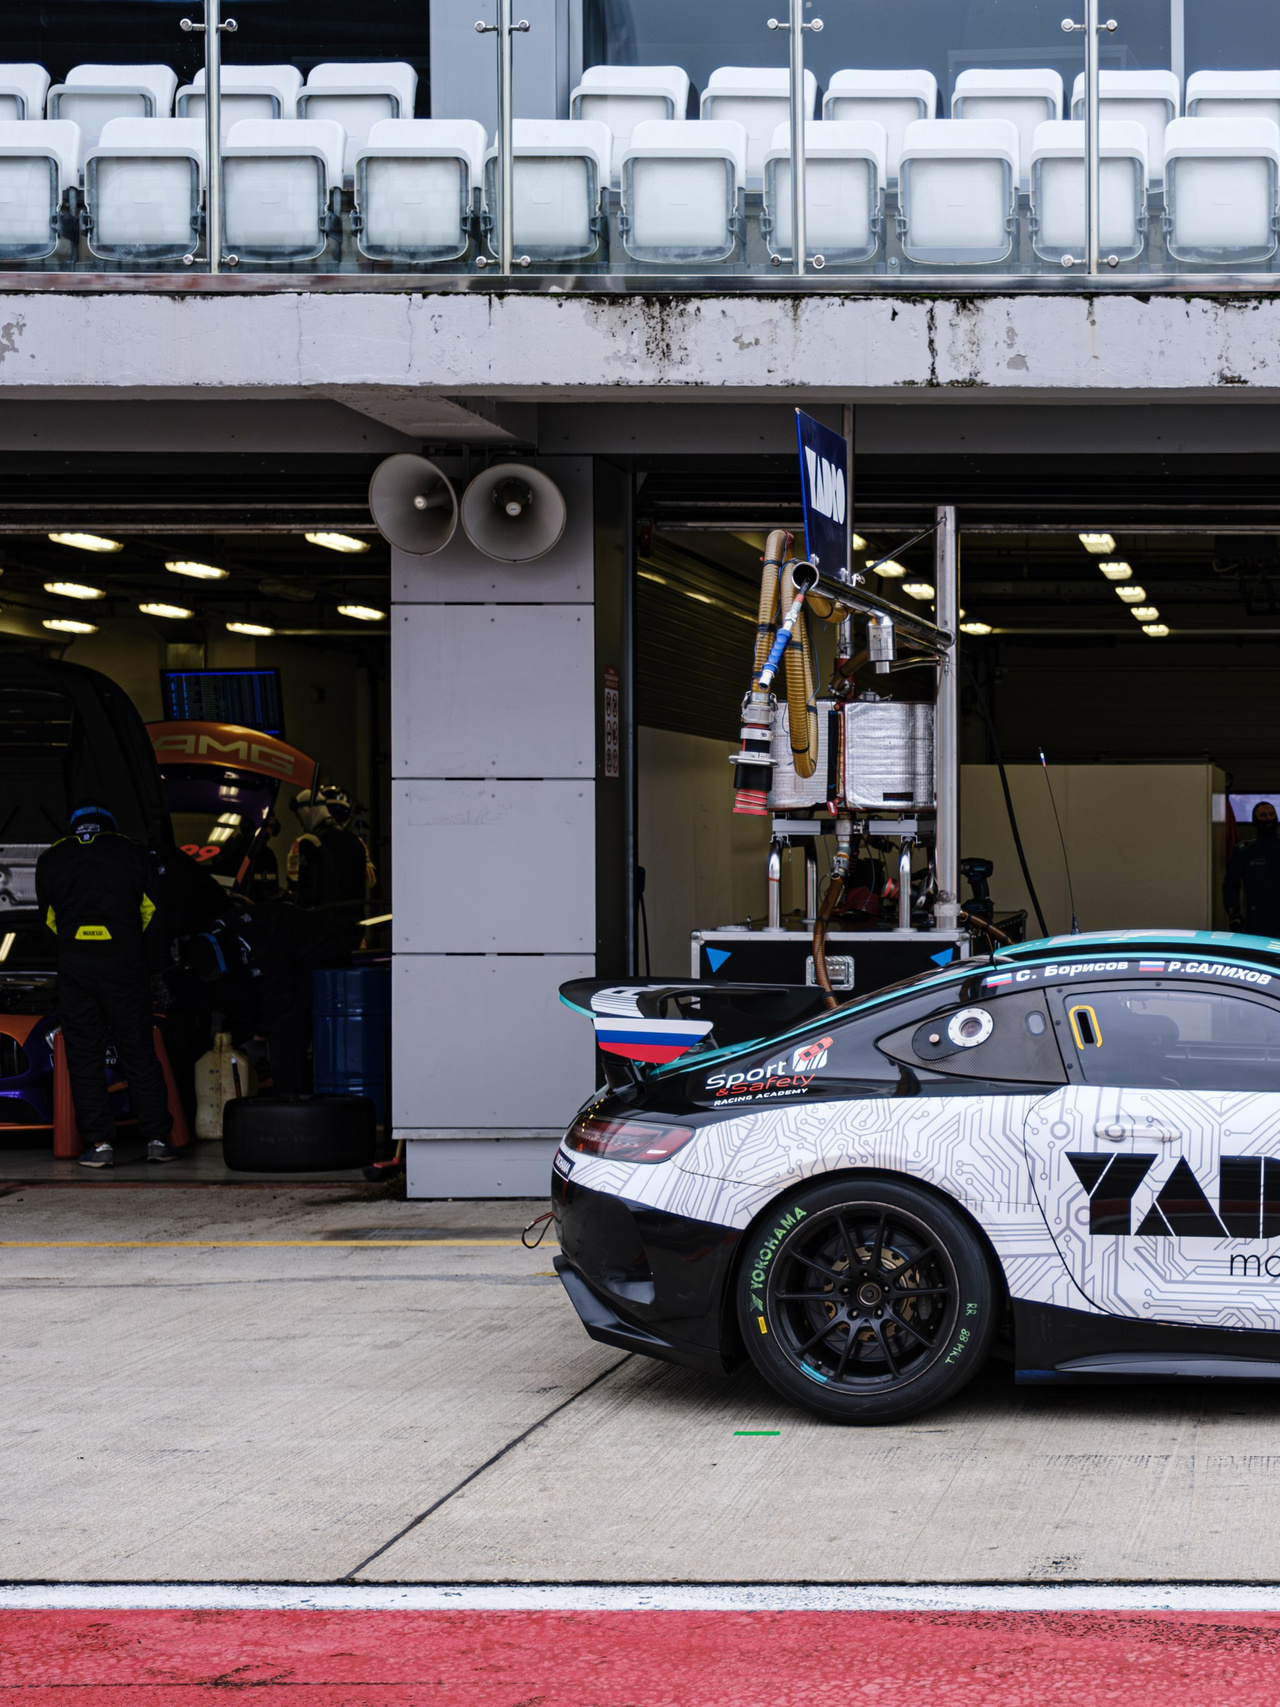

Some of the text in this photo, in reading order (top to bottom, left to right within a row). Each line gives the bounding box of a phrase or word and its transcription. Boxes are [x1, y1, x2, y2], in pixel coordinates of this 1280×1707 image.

[152, 734, 296, 776] AMG
[1015, 960, 1129, 981] С. Борисов
[1167, 961, 1272, 985] Р.САЛИХОВ
[705, 1060, 788, 1091] Sport
[714, 1087, 809, 1106] RACING ACADEMY
[750, 1206, 807, 1290] YOKOHAMA
[965, 1302, 977, 1316] RR
